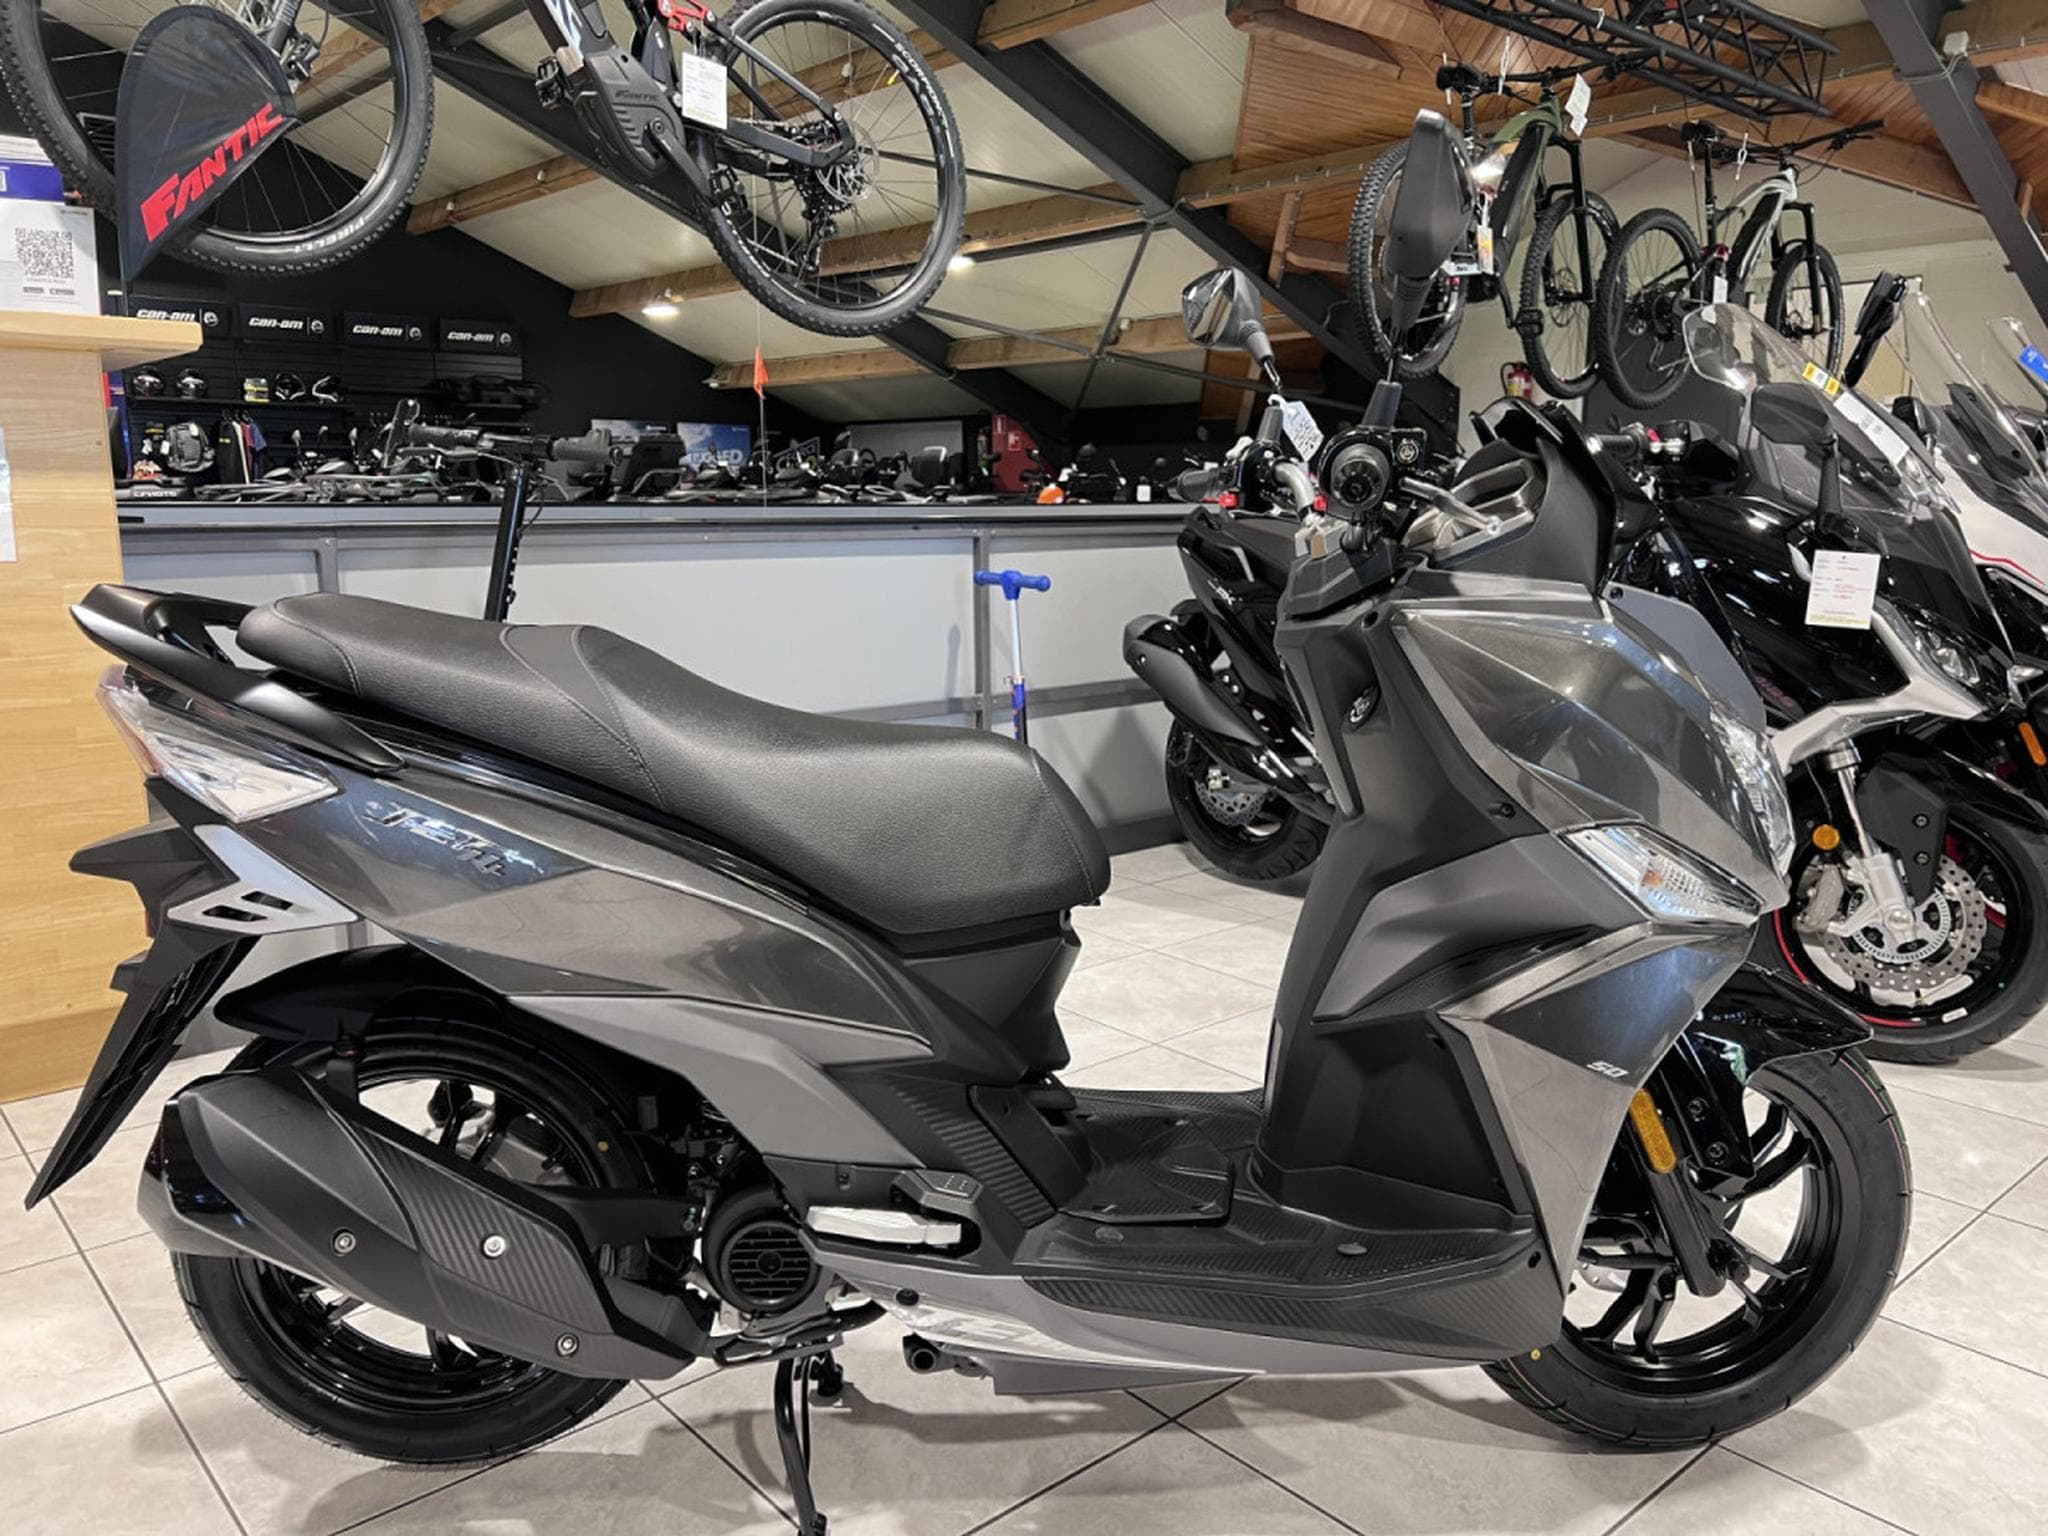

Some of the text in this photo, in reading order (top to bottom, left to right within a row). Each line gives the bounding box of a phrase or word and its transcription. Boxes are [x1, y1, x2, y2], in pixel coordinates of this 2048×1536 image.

[140, 102, 285, 243] FANTIC
[294, 216, 366, 253] PIRELLI
[249, 316, 304, 331] can-am
[352, 323, 404, 337] can-am
[447, 329, 495, 343] can-am
[1586, 1060, 1629, 1078] 50
